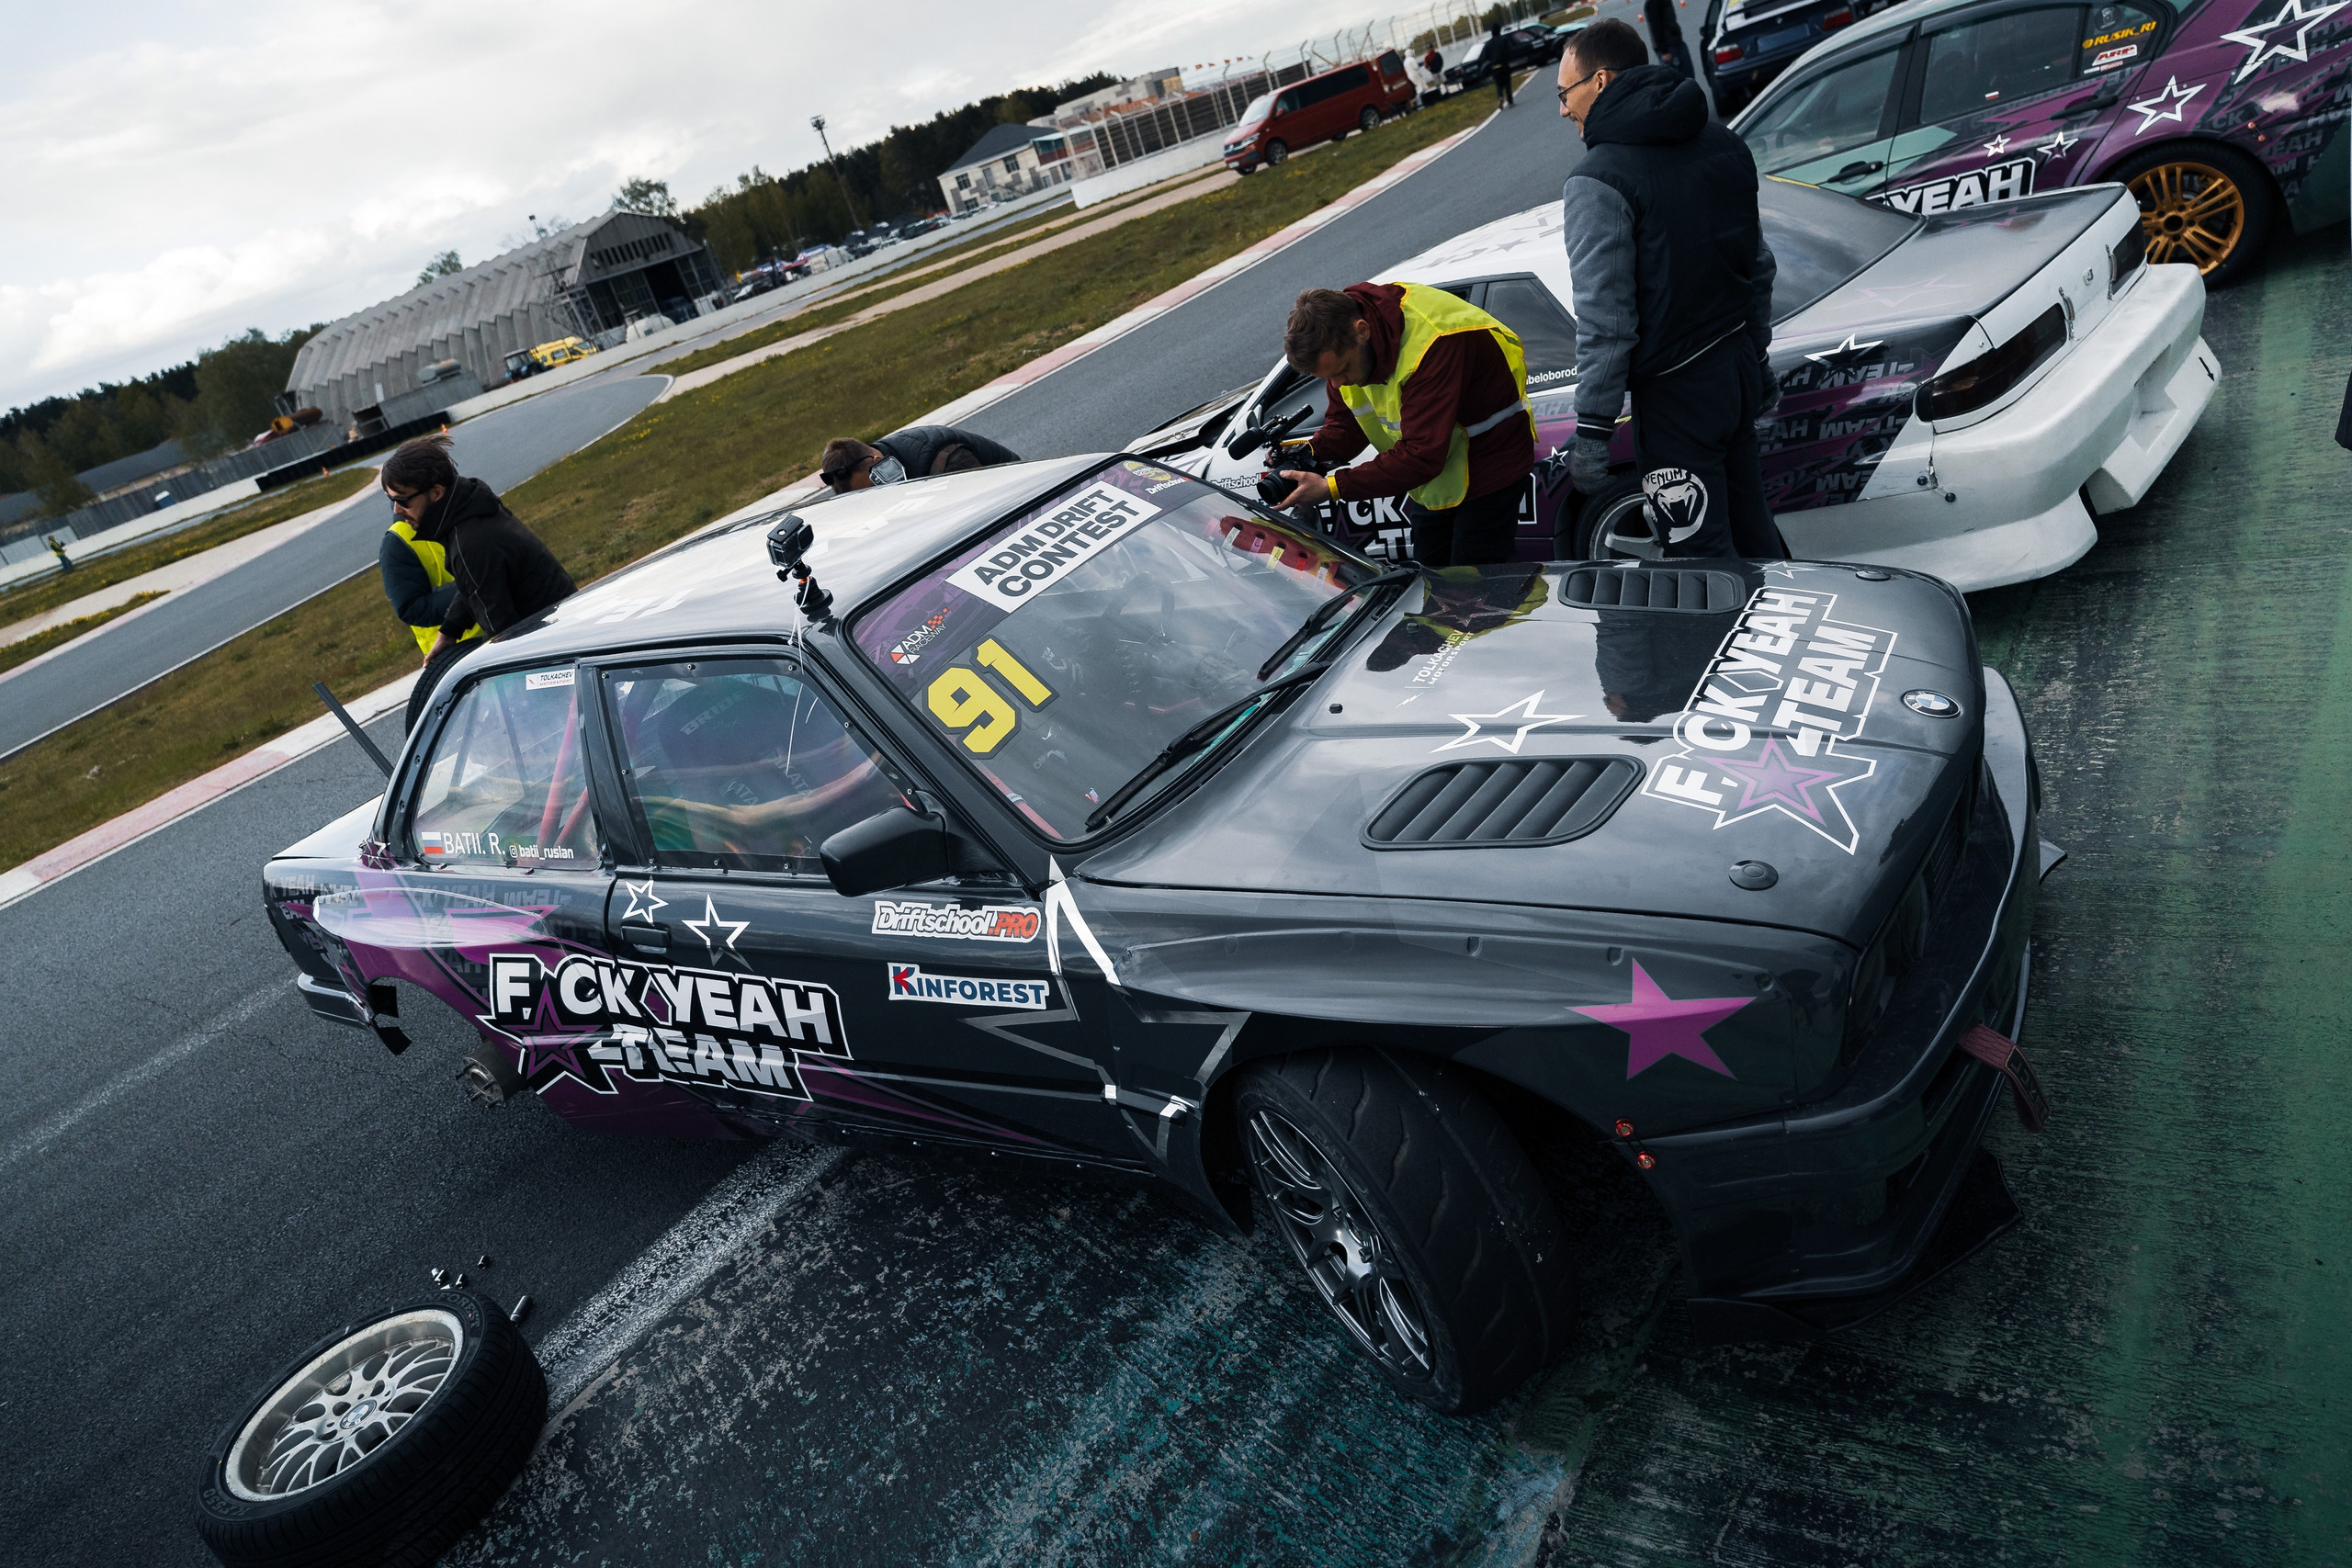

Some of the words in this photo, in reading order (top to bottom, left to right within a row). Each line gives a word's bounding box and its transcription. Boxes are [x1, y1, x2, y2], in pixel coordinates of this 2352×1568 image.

[1645, 468, 1684, 487] VENUM
[974, 534, 1047, 586] ADM
[1035, 489, 1114, 539] DRIFT
[997, 500, 1140, 597] CONTEST
[901, 624, 933, 650] ADM
[908, 623, 947, 654] RACEWAY
[1411, 628, 1464, 683] TOLKACHEV
[1427, 631, 1475, 685] MOTORSPORT
[1716, 591, 1818, 675] YEAH
[540, 671, 574, 682] TOLKACHEV
[926, 637, 1056, 755] 91
[1770, 625, 1877, 732] TEAM
[488, 832, 506, 856] R.
[655, 971, 832, 1045] YEAH
[891, 965, 1046, 1005] KINFOREST
[614, 1023, 794, 1090] TEAM
